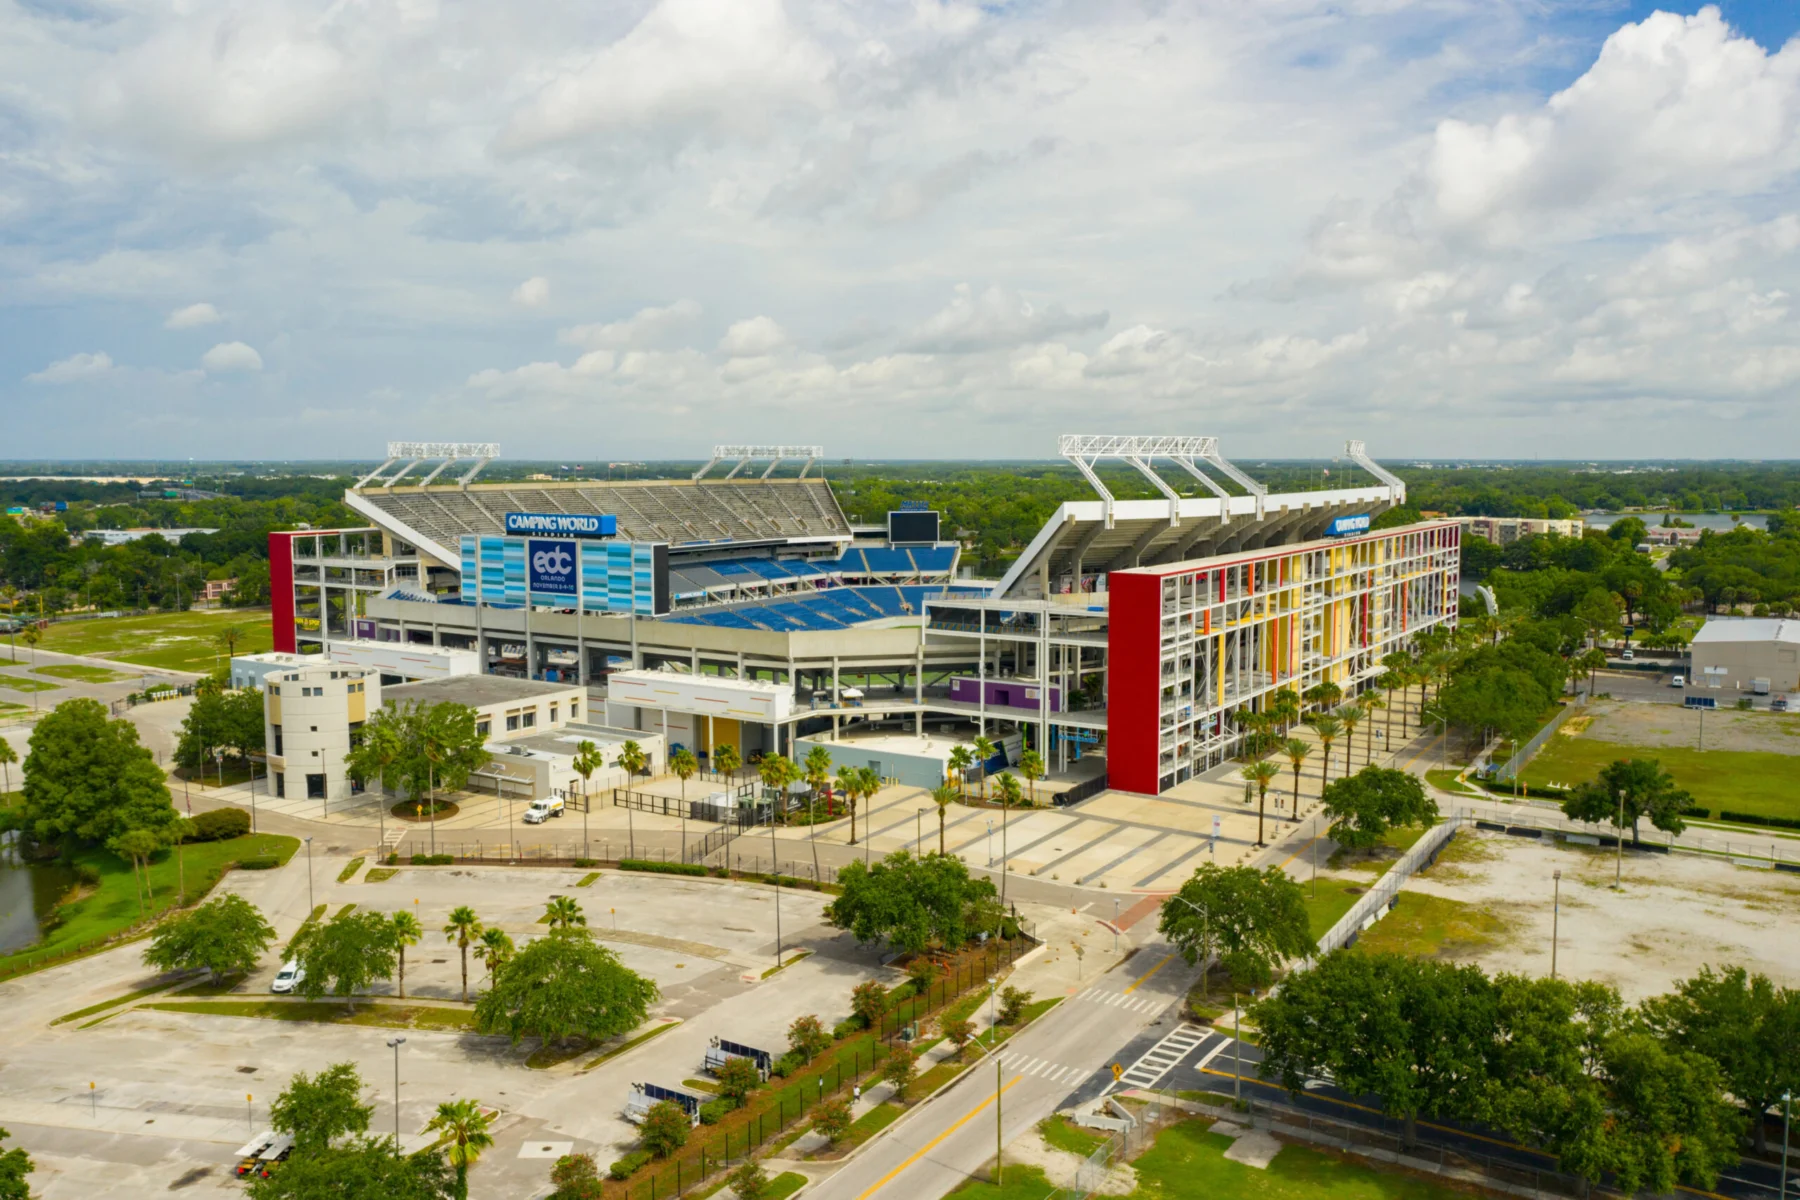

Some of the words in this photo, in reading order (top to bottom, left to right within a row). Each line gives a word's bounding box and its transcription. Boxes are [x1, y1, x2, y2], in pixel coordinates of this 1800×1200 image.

[508, 515, 556, 530] CAMPING
[557, 517, 598, 531] WORLD
[533, 545, 572, 575] edc
